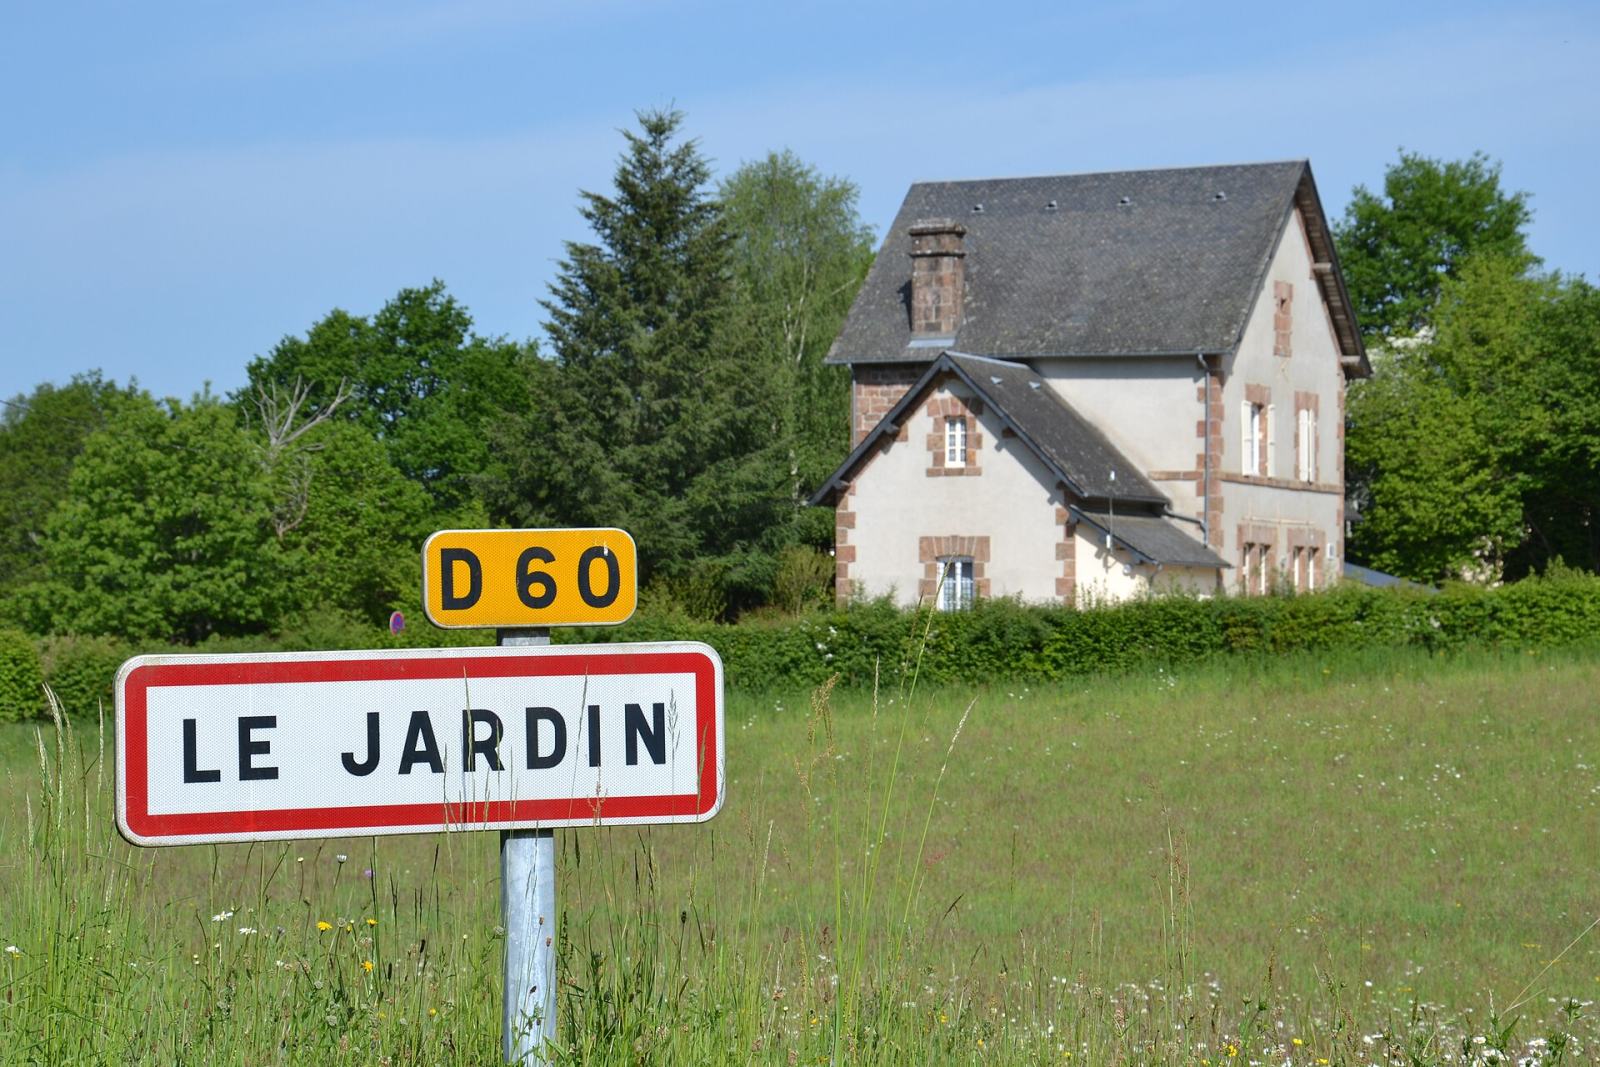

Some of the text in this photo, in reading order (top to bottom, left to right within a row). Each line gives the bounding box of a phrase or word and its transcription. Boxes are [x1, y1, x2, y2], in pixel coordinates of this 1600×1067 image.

[440, 545, 621, 611] D 60
[182, 702, 667, 784] LE JARDIN
